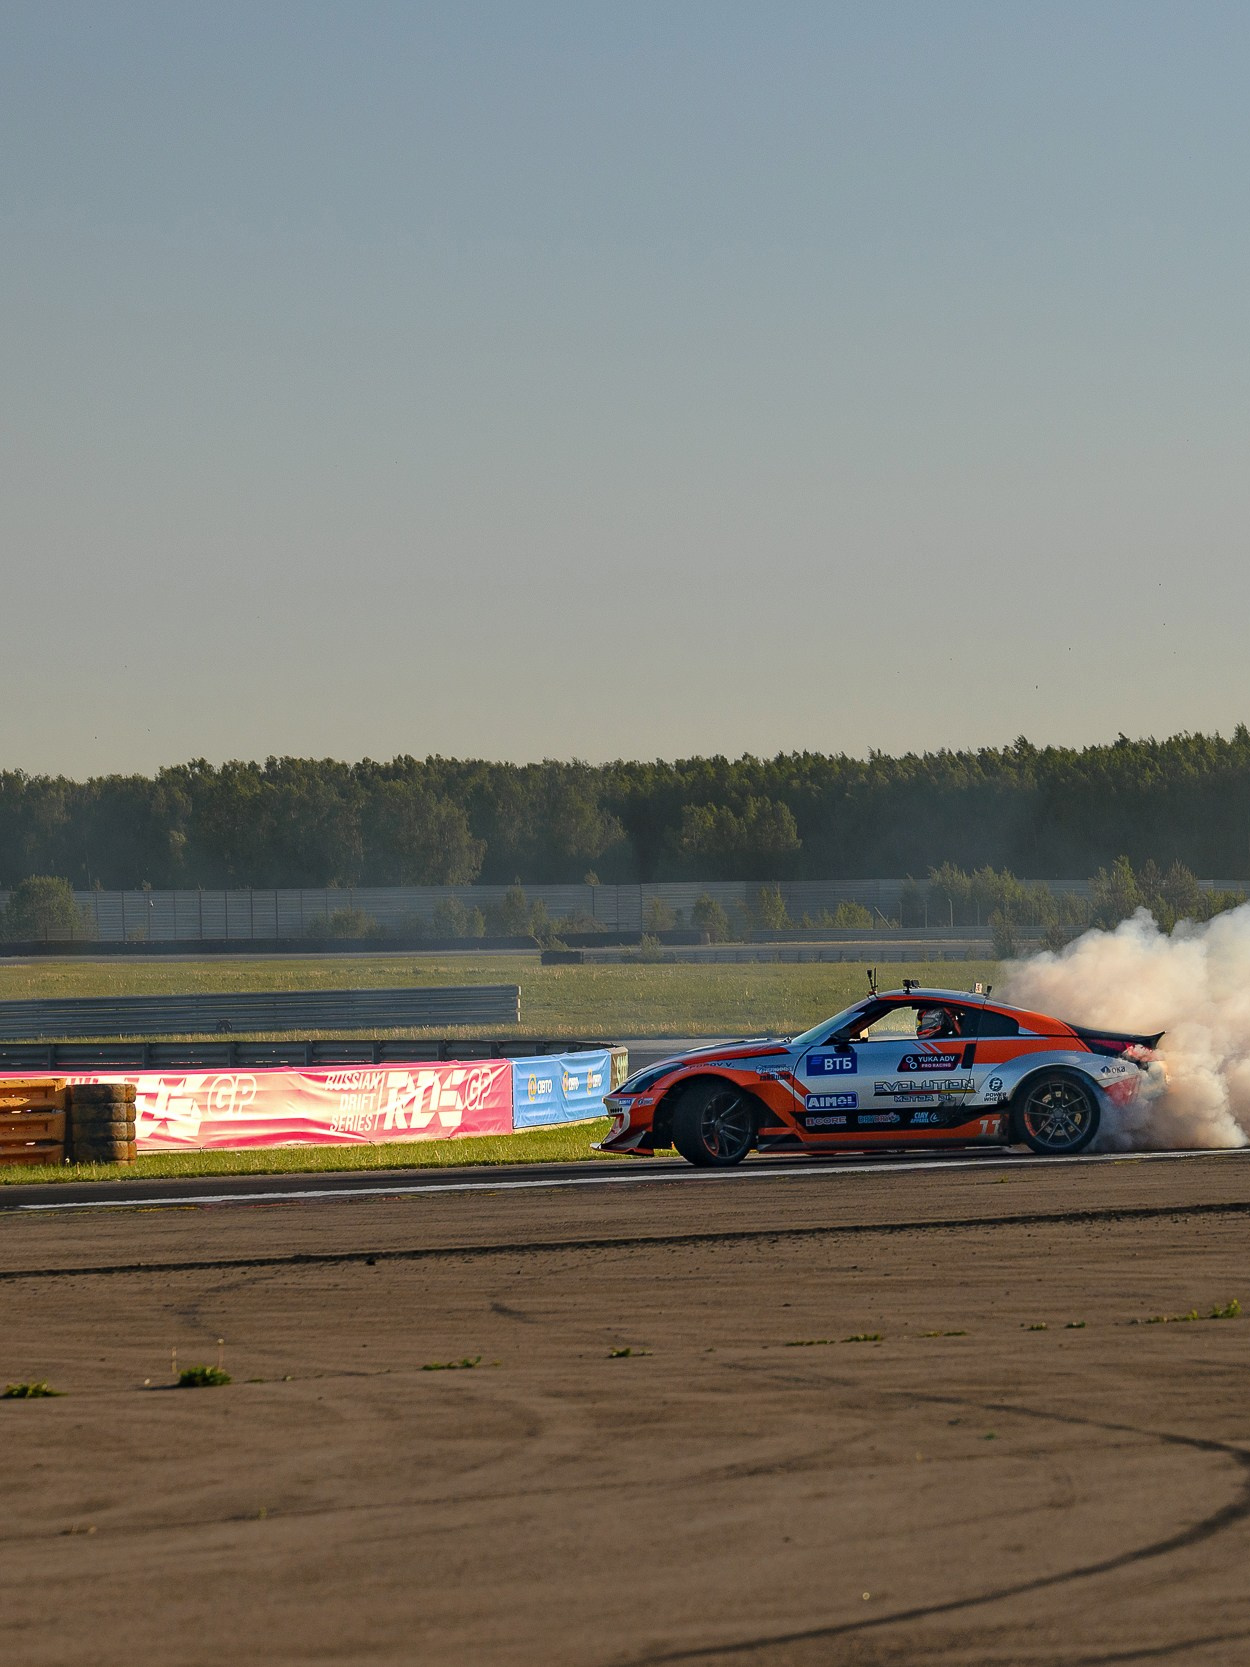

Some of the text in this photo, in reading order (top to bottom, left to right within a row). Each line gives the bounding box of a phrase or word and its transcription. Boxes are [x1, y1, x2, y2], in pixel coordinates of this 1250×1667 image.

[824, 1058, 852, 1071] ВТБ
[325, 1072, 379, 1090] RUSSIAN
[465, 1068, 493, 1111] GP
[874, 1079, 975, 1092] EVOLUTION
[207, 1074, 257, 1116] GP
[340, 1093, 376, 1110] DRIFT
[808, 1096, 855, 1107] AIMOL
[894, 1095, 934, 1103] MOTOR
[330, 1114, 373, 1132] SERIES
